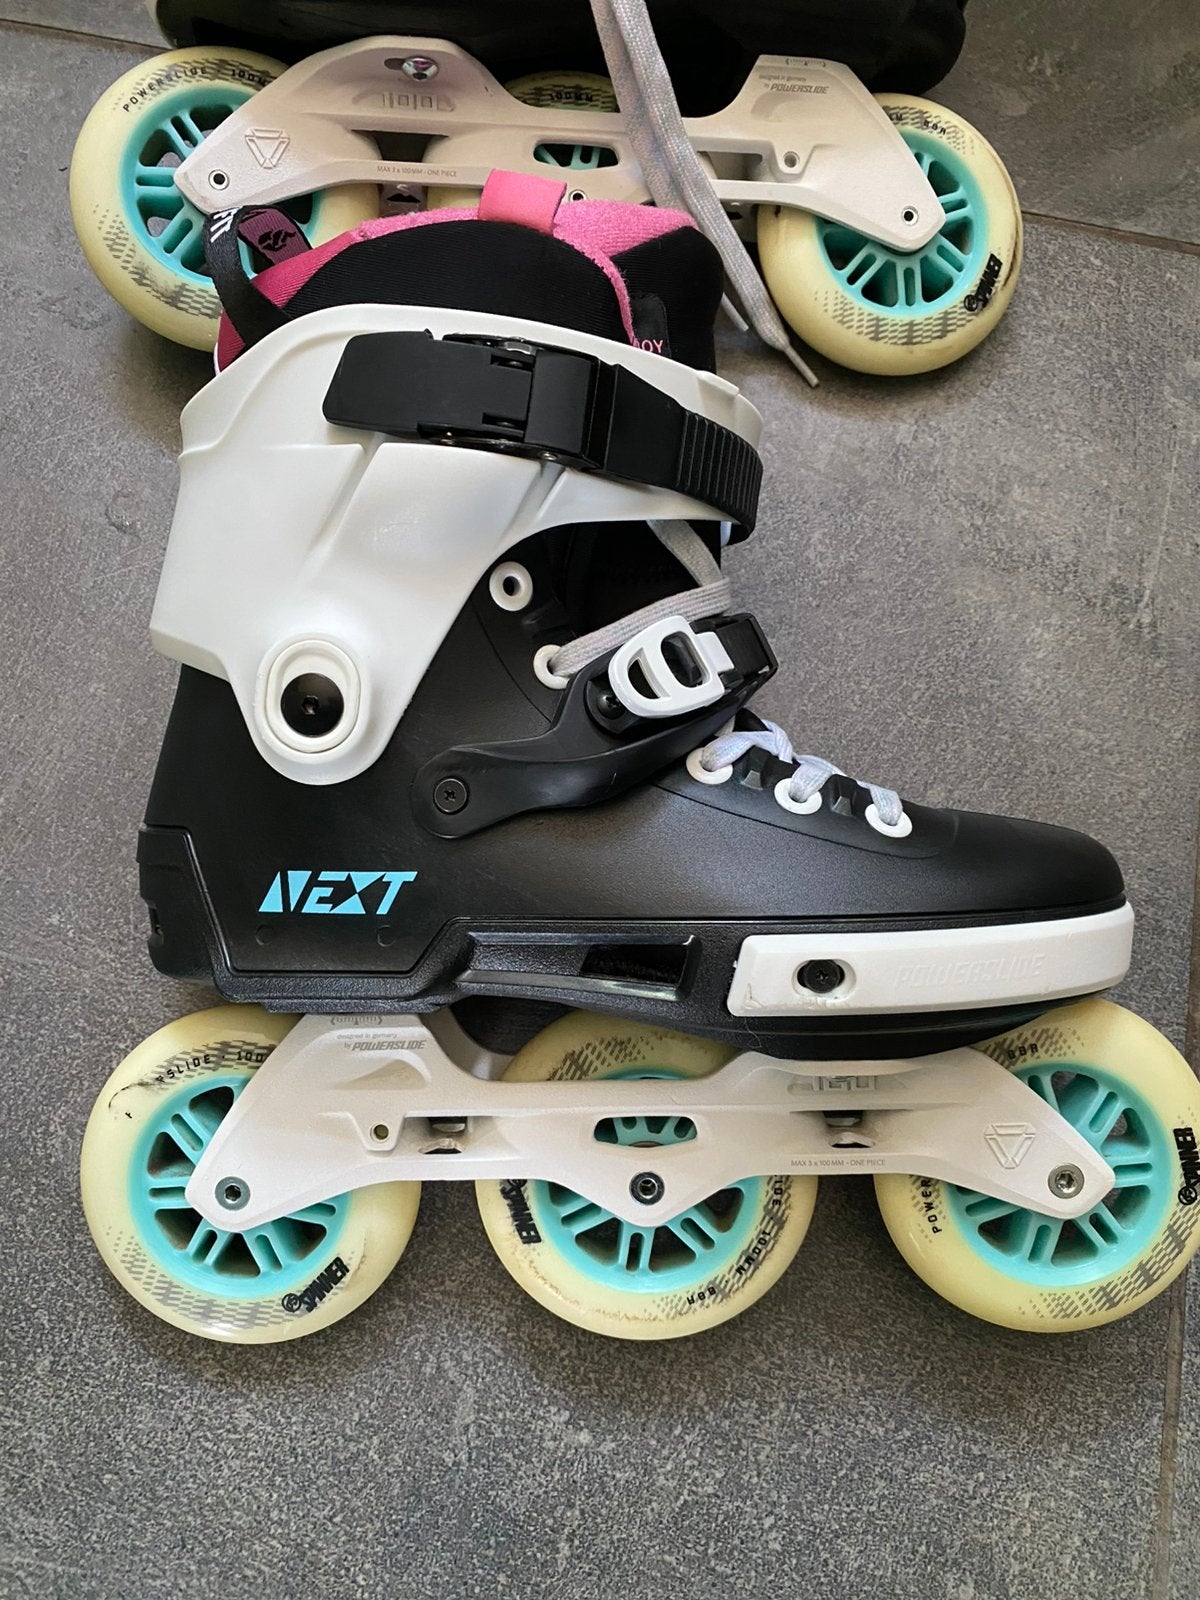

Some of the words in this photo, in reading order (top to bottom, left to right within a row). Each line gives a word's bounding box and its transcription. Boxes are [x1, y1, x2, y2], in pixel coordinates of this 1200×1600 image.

[122, 66, 207, 112] POWERSLIDE
[770, 82, 829, 94] POWERSLIDE
[258, 870, 418, 915] NEXT
[893, 953, 1046, 988] POWERSLIDE
[352, 1039, 428, 1051] POWERSLIDE
[790, 1159, 807, 1167] MAX
[820, 1159, 845, 1167] 100MM
[850, 1159, 865, 1167] ONE
[866, 1159, 886, 1167] PIECE
[735, 1229, 771, 1276] 100MM
[299, 1256, 350, 1313] SPINNER
